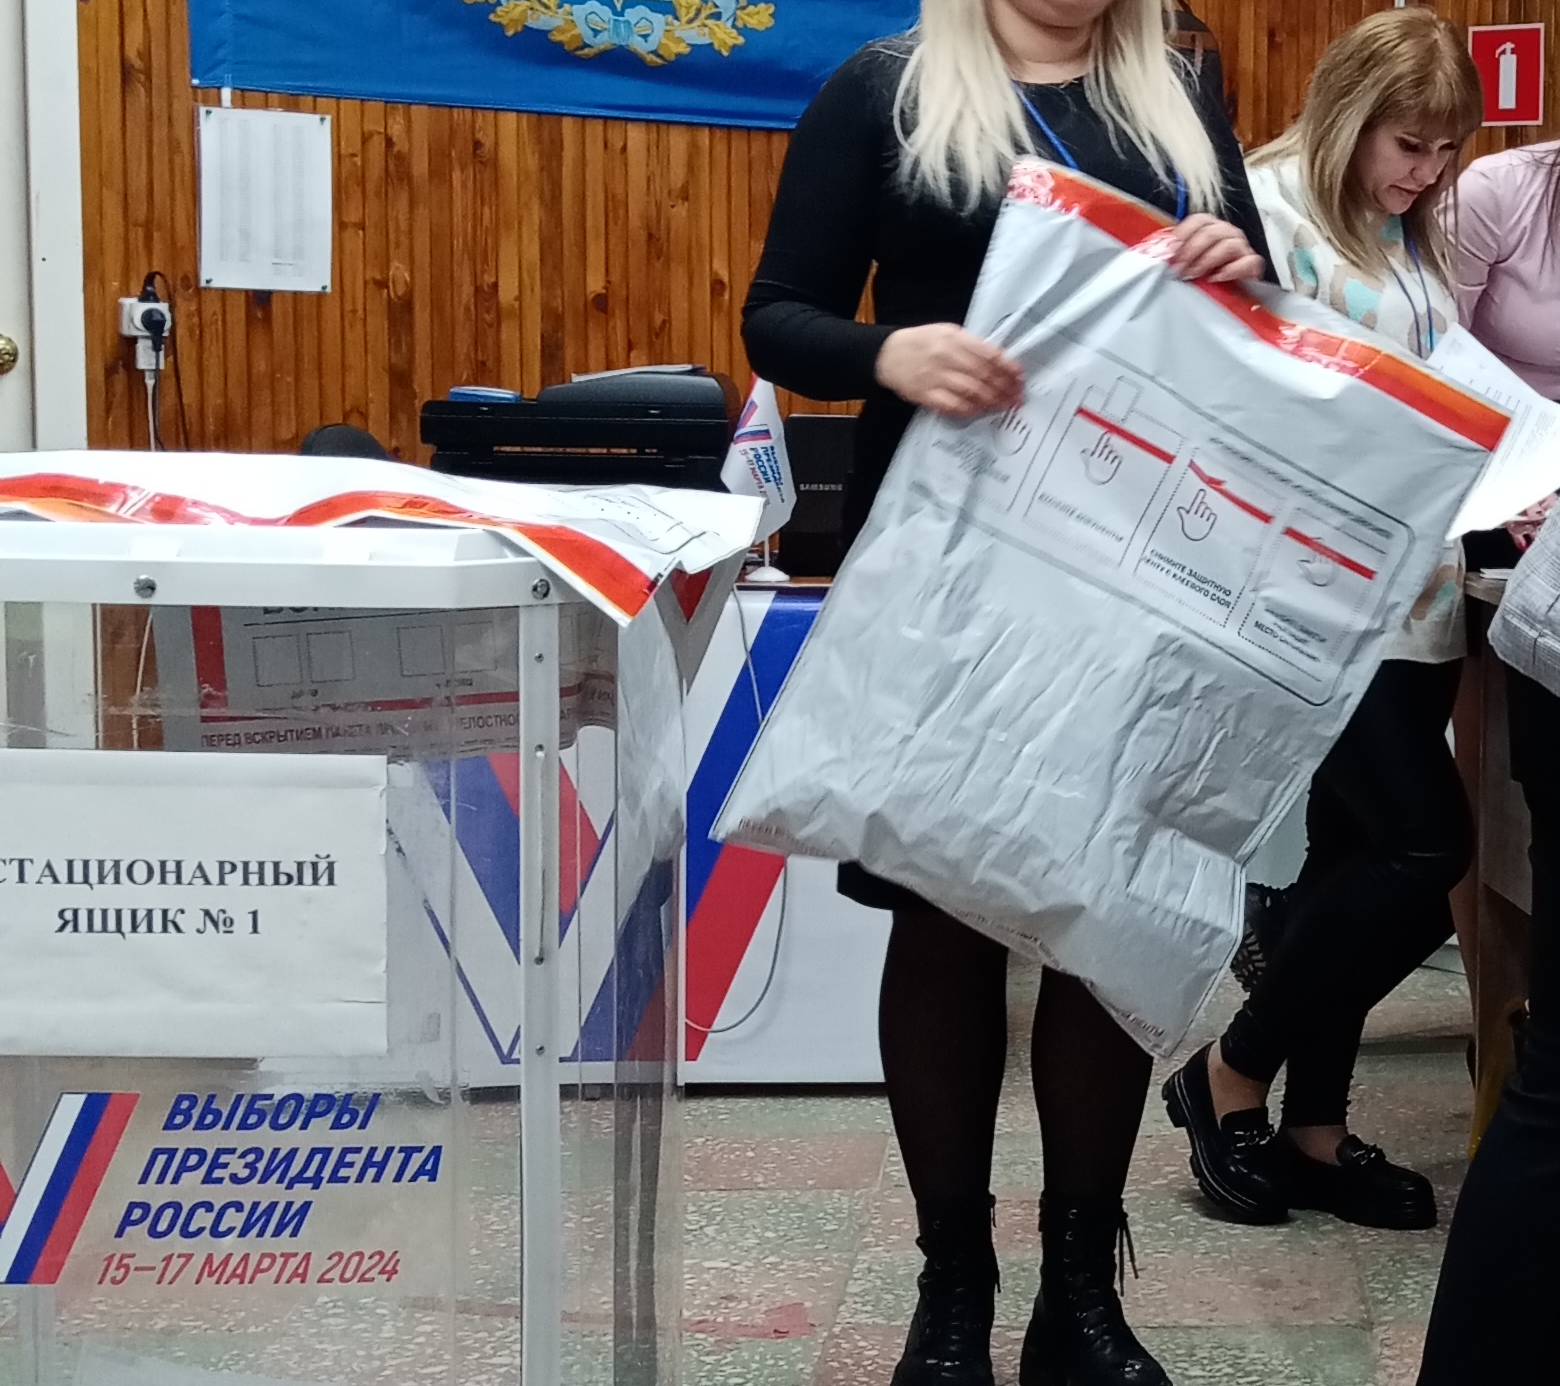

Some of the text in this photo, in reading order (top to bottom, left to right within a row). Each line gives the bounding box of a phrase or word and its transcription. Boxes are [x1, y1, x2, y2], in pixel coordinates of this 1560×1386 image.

[1187, 568, 1232, 597] ЗАЩИТНУЮ
[245, 726, 323, 745] ВСКРЫТИЕМ
[54, 907, 187, 940] ЯЩИК
[161, 1092, 383, 1132] ВЫБОРЫ
[137, 1145, 443, 1191] ПРЕЗИДЕНТА
[113, 1200, 314, 1239] РОССИИ
[194, 1251, 313, 1286] МАРТА
[316, 1250, 401, 1284] 2024
